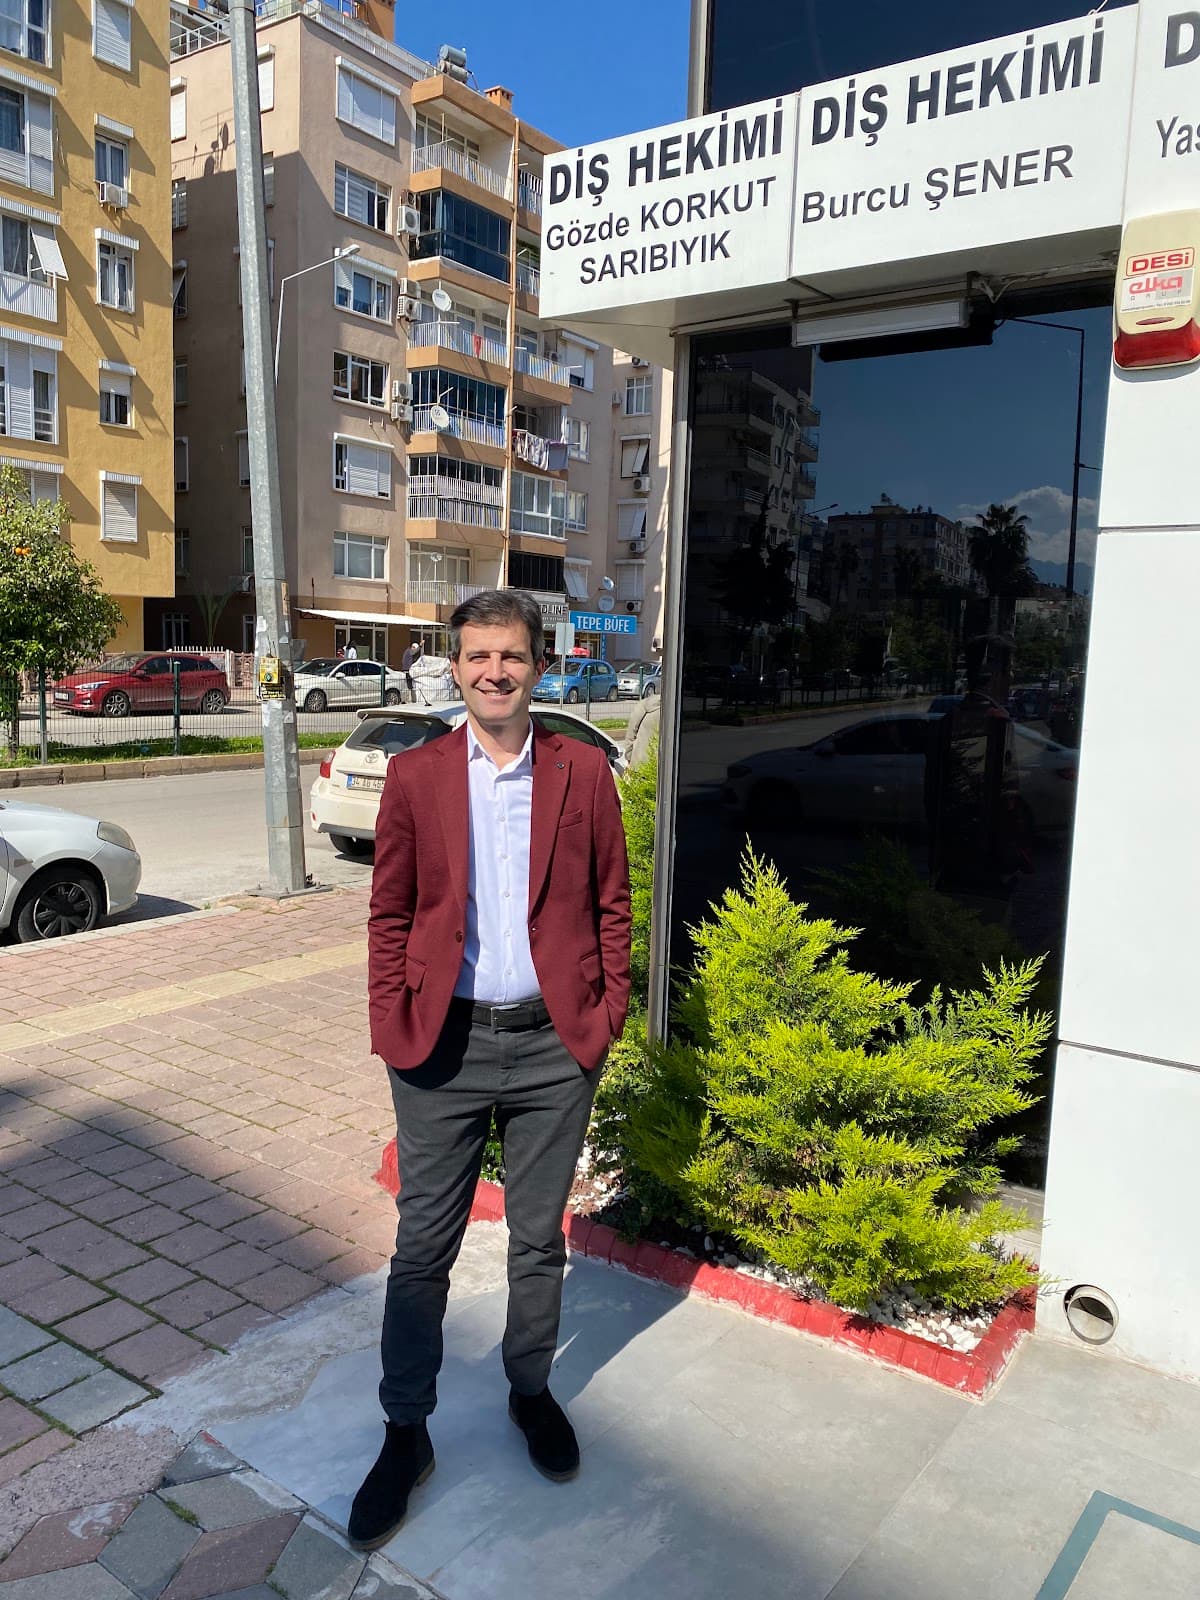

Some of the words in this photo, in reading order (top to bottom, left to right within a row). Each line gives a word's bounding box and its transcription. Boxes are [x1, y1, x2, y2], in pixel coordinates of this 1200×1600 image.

[812, 79, 888, 147] DİŞ
[907, 17, 1105, 125] HEKİMİ
[550, 149, 610, 206] DİŞ
[628, 98, 784, 187] HEKİMİ
[802, 182, 910, 224] Burcu
[924, 144, 1074, 211] ŞENER
[546, 213, 630, 251] Gözde
[640, 176, 777, 233] KORKUT
[579, 230, 732, 285] SARIBIYIK
[577, 615, 602, 631] TEPE
[604, 615, 630, 632] BÜFE
